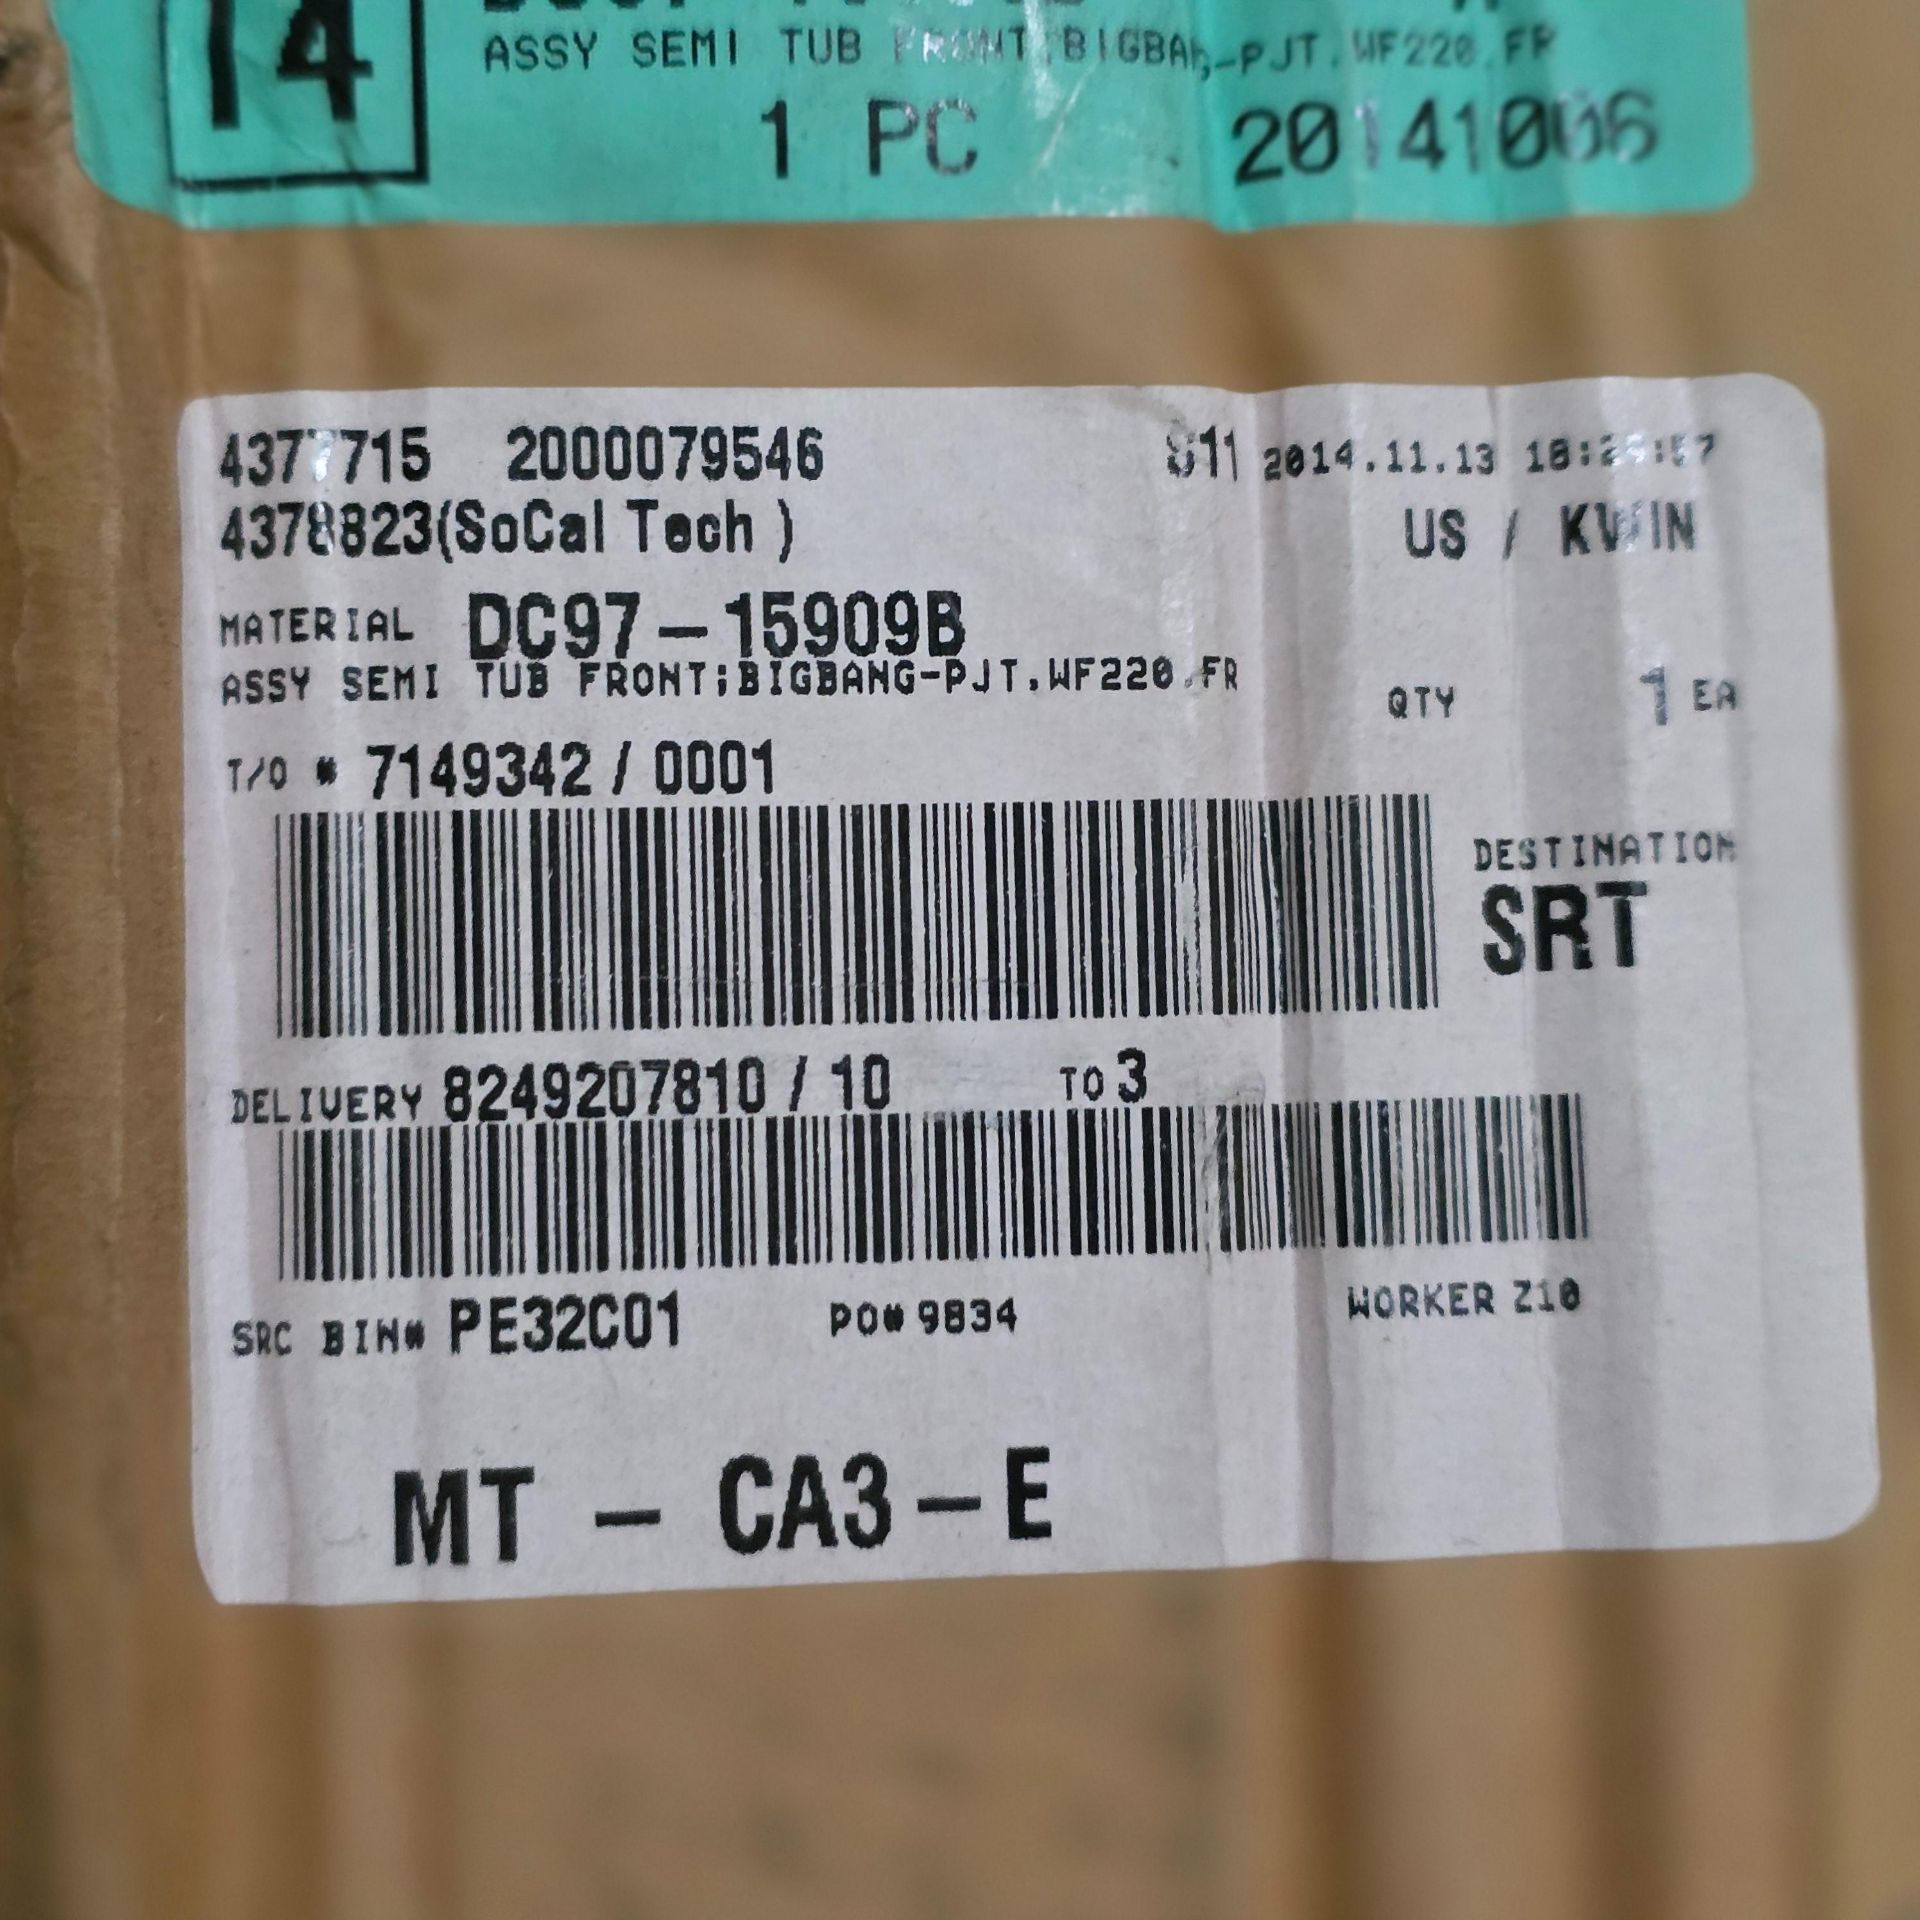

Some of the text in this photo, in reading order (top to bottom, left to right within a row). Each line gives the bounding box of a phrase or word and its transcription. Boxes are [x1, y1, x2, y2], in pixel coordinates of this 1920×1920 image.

[484, 34, 598, 72] ASSY
[632, 29, 738, 68] SEMI
[779, 27, 863, 65] TUB
[761, 98, 978, 178] 1 PC
[1232, 88, 1660, 187] 20141006
[507, 425, 825, 481] 2000079546
[1263, 438, 1496, 481] 2014.11.13
[220, 499, 793, 563] 4378823(SoCal Tech )
[1404, 499, 1695, 561] US / KWIN
[219, 591, 966, 660] MATERIAL DC97-15909B
[221, 664, 312, 706] ASSY
[342, 664, 441, 703] SEMI
[477, 661, 549, 698] TUB
[1387, 666, 1740, 727] QTY 1 EA
[365, 742, 594, 801] 7149342
[611, 741, 633, 796] /
[654, 739, 775, 795] 0001
[1473, 831, 1738, 872] DESTINATION
[1481, 880, 1649, 976] SRT
[230, 1047, 1149, 1125] DELIVERY 8249207810 / 10 TO 3
[232, 1320, 293, 1357] SRC
[448, 1290, 681, 1355] PE32C01
[918, 1297, 1018, 1335] 9834
[1347, 1280, 1495, 1320] WORKER
[1513, 1277, 1582, 1314] Z10
[394, 1466, 535, 1567] MT
[594, 1508, 662, 1528] -
